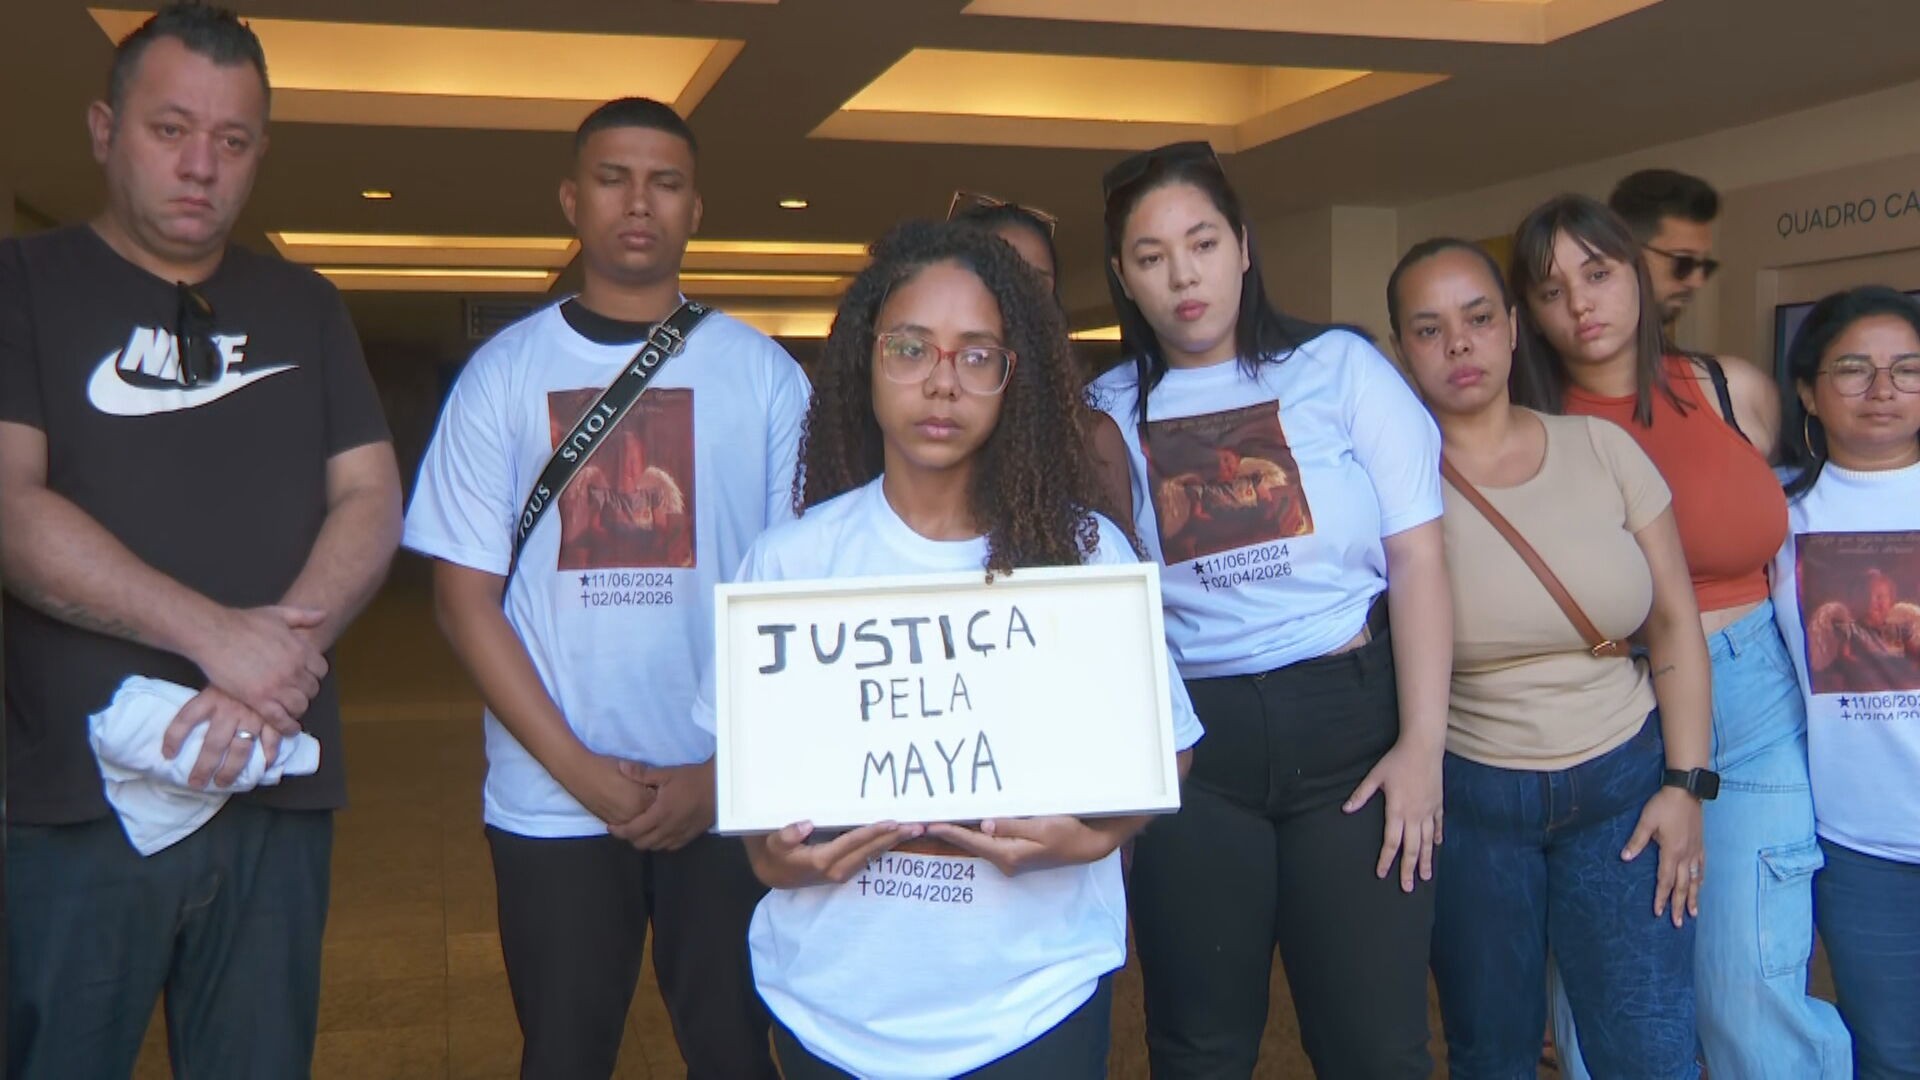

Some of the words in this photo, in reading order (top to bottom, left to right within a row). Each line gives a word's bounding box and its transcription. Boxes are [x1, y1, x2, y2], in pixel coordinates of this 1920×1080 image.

[1777, 198, 1876, 239] QUADRO
[563, 403, 618, 463] TOUS
[1205, 543, 1290, 575] 11/06/2024
[1211, 561, 1292, 589] 02/04/2026
[592, 572, 673, 588] 11/06/2024
[591, 590, 674, 607] 02/04/2026
[757, 605, 1037, 674] JUSTIÇA
[859, 672, 972, 722] PELA
[860, 730, 1002, 799] MAYA
[875, 857, 976, 881] 11/06/2024
[873, 879, 974, 904] 02/04/2026
